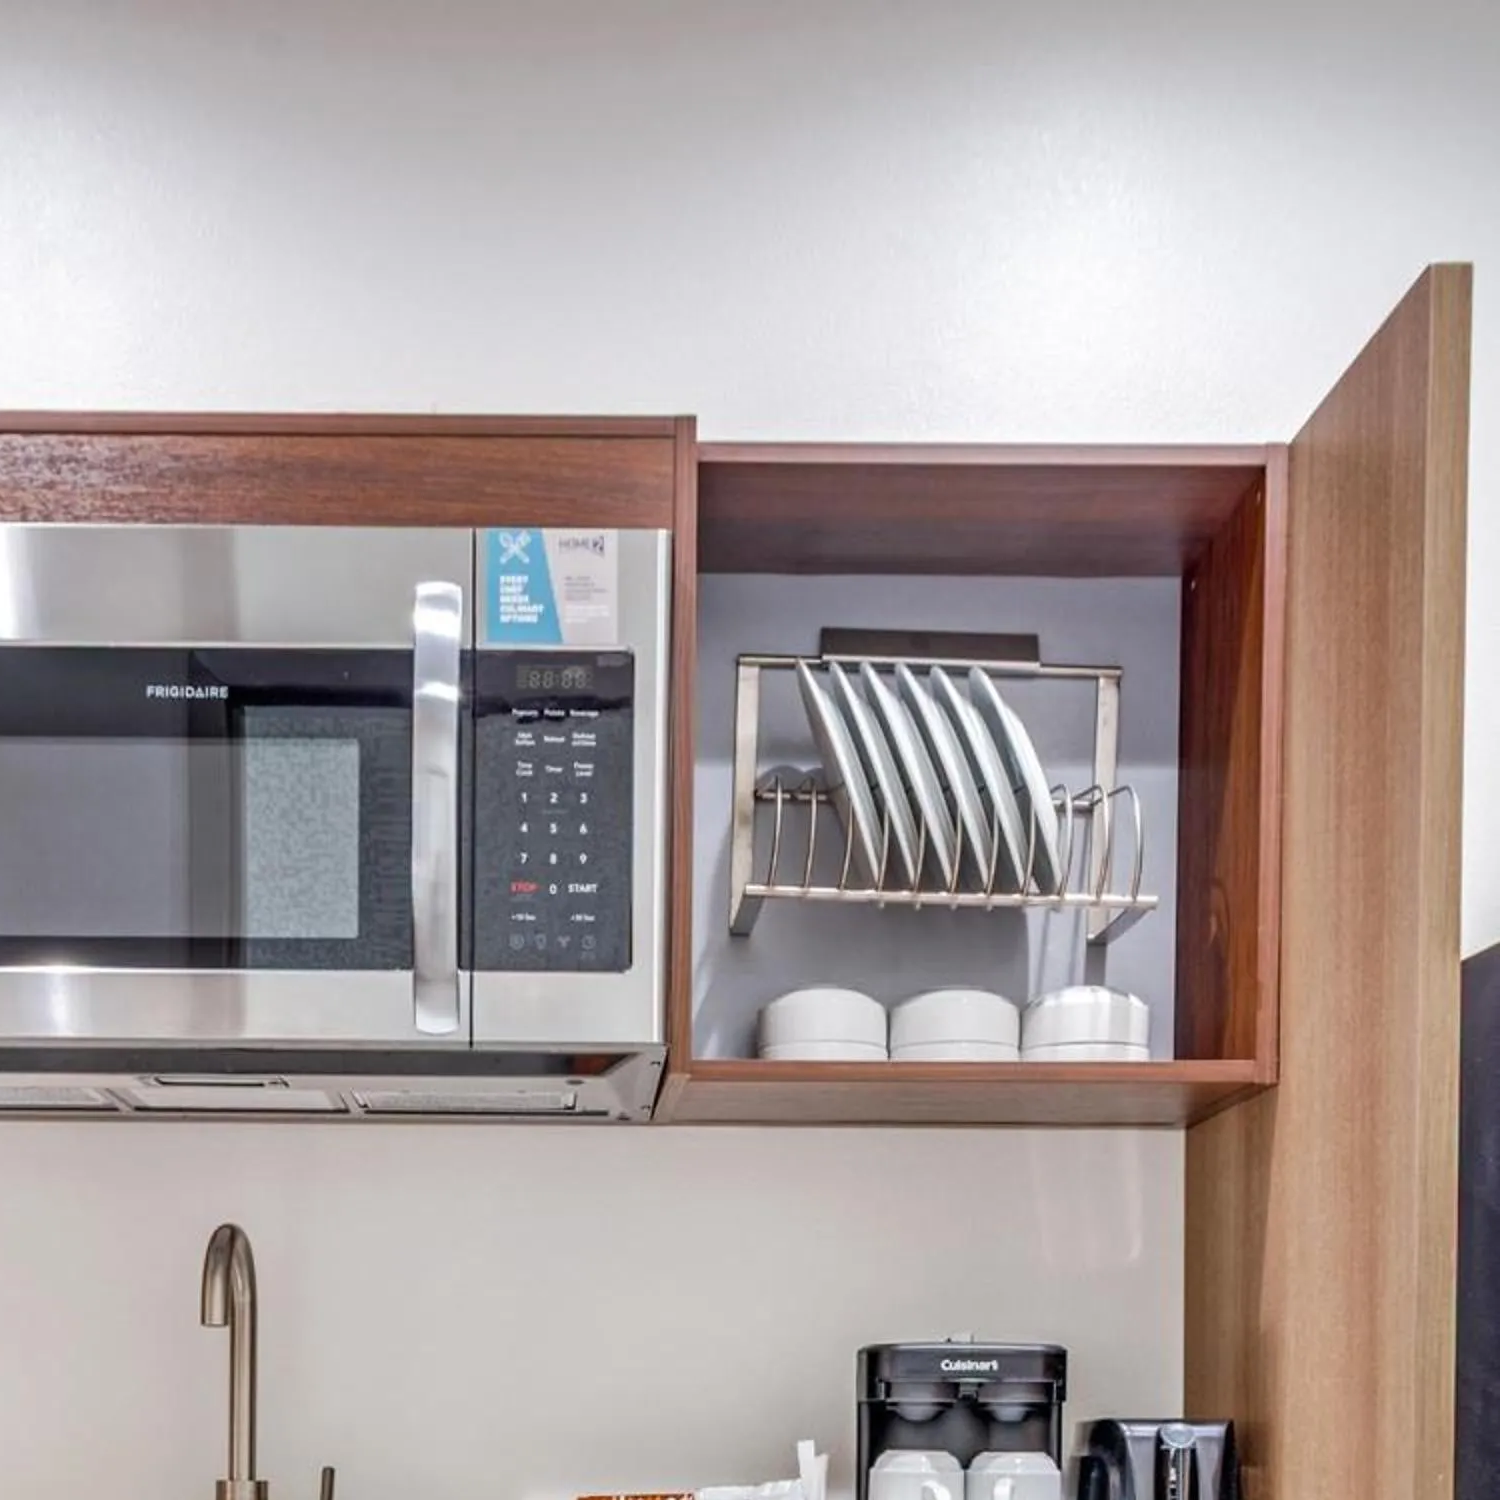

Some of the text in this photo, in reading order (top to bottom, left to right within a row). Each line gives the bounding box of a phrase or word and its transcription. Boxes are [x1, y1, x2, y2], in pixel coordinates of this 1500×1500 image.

[146, 684, 229, 699] FRIGIDAIRE
[521, 792, 528, 803] 1
[550, 792, 559, 804] 2
[580, 792, 588, 804] 3
[520, 822, 528, 833] 4
[579, 823, 588, 834] 6
[520, 852, 529, 864] 7
[550, 853, 558, 865] 8
[579, 852, 588, 865] 9
[549, 883, 558, 895] 0
[567, 883, 598, 893] START
[941, 1359, 999, 1372] Cuisinart
